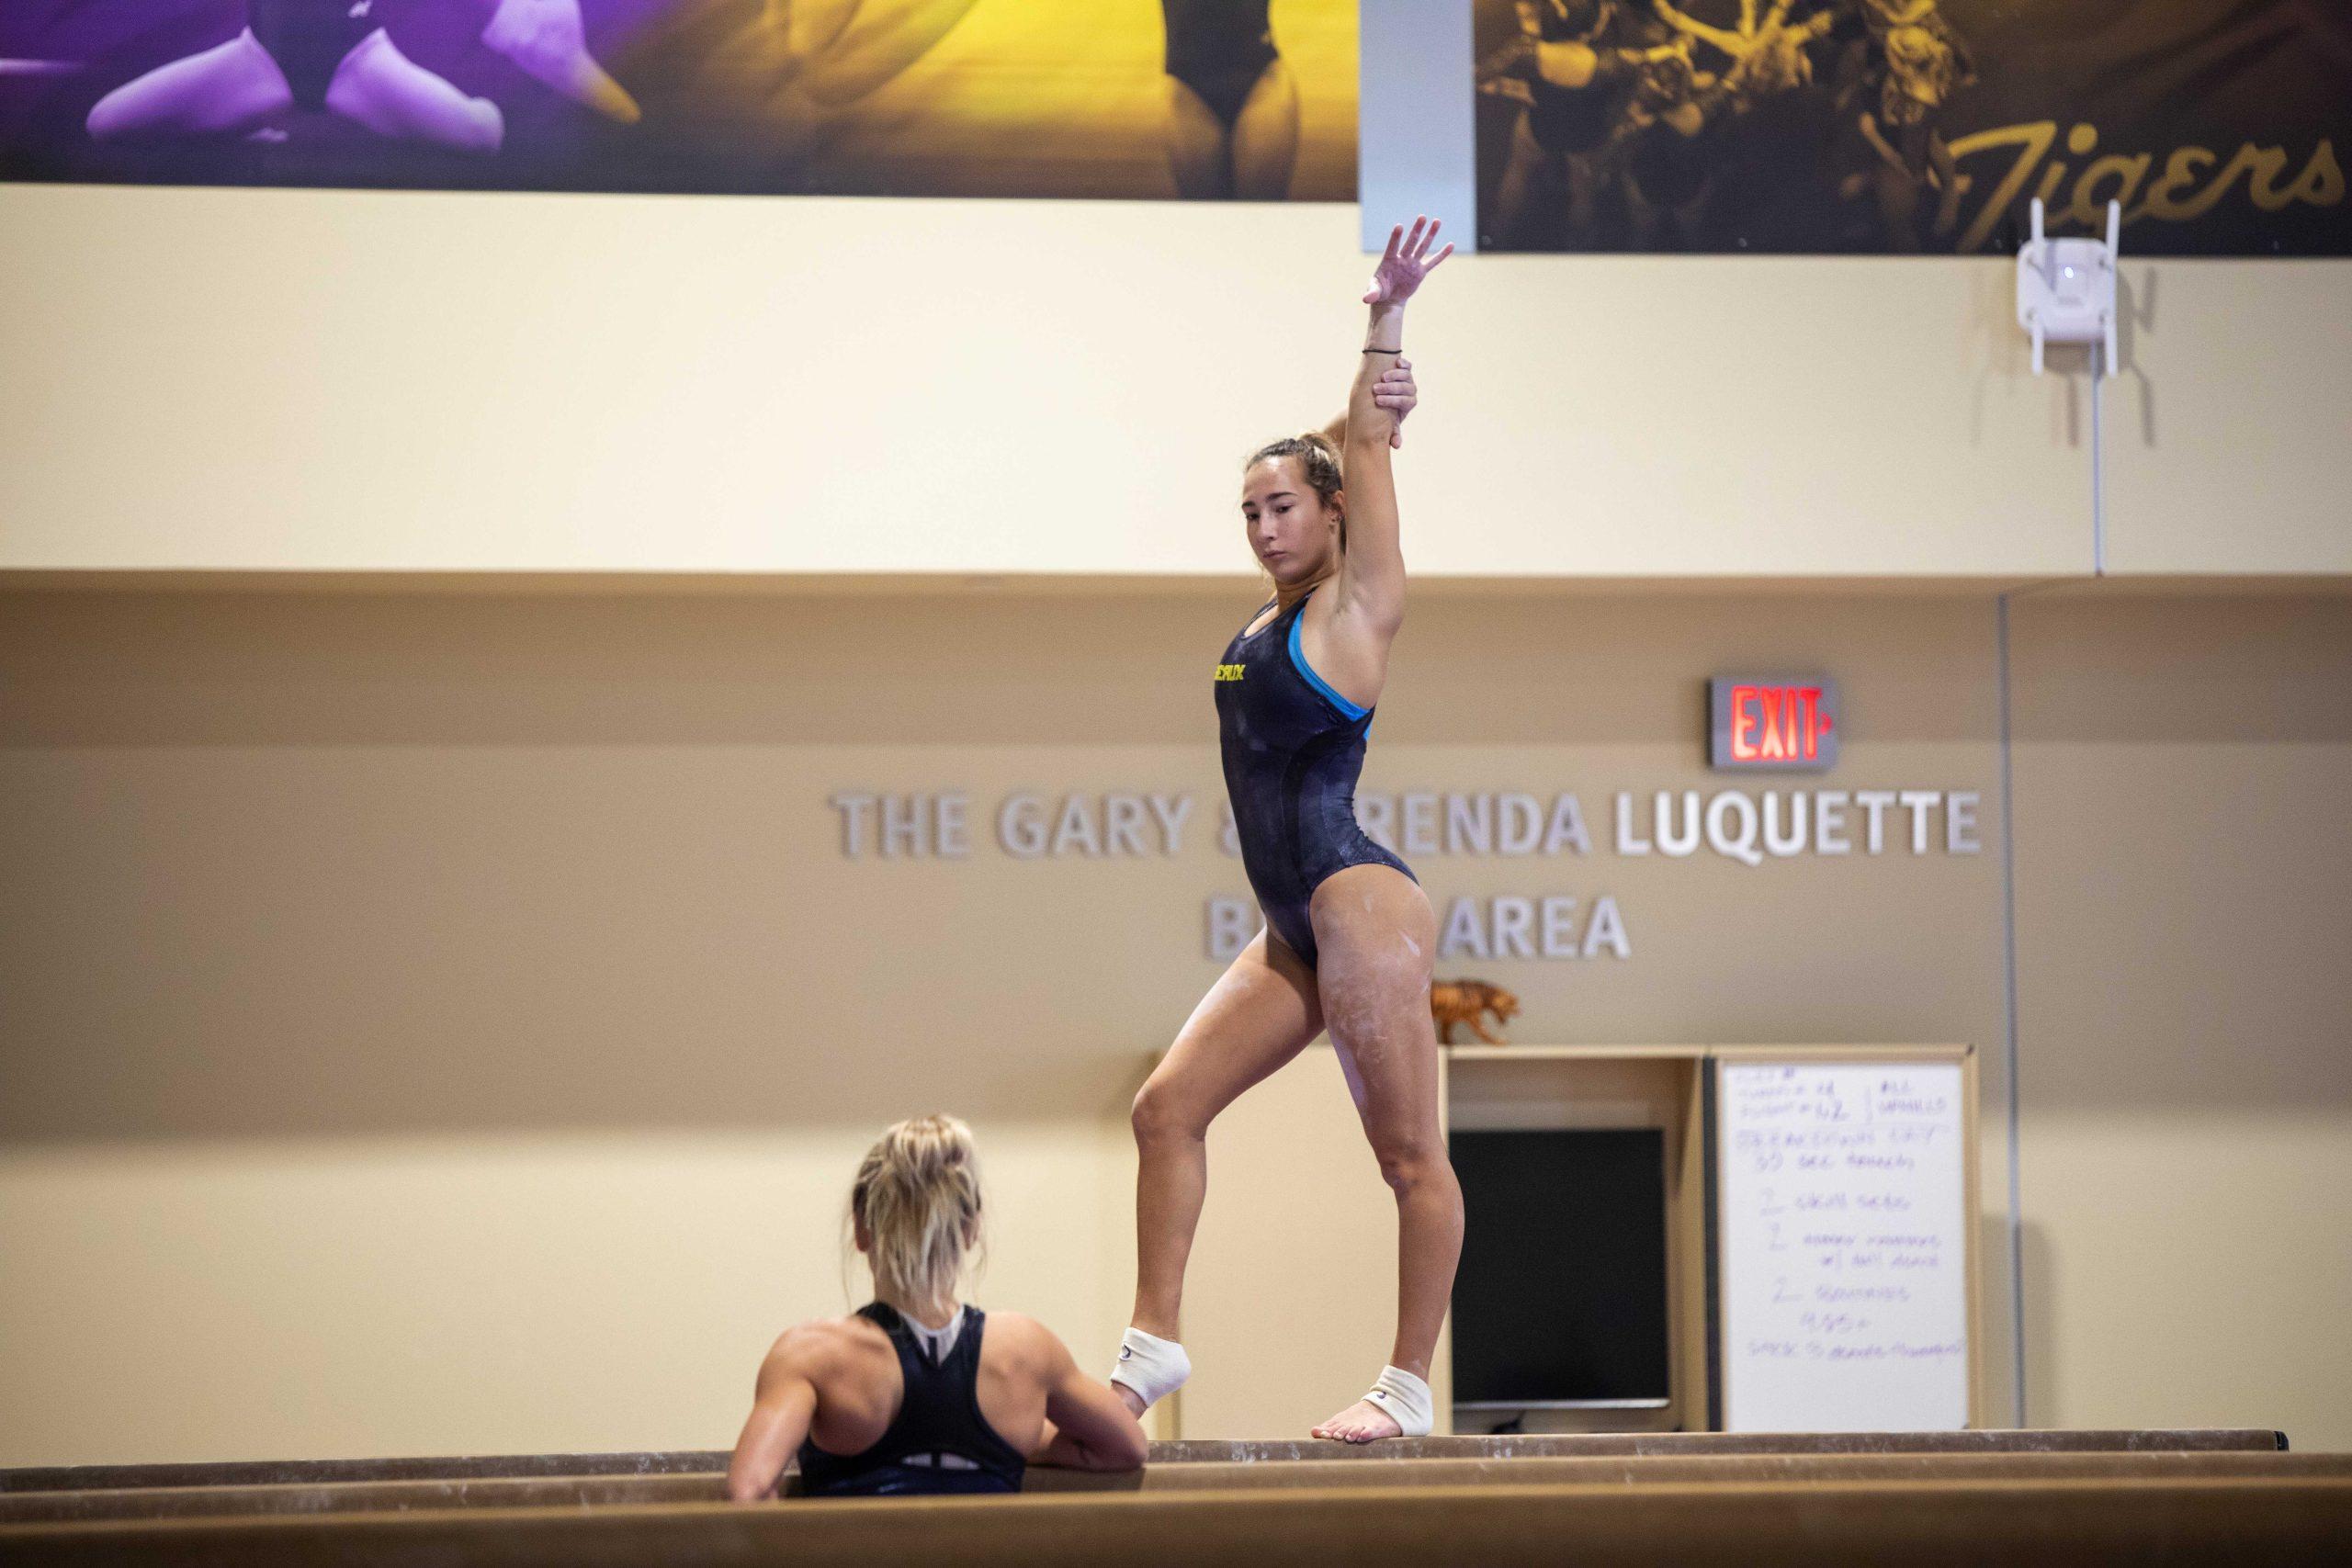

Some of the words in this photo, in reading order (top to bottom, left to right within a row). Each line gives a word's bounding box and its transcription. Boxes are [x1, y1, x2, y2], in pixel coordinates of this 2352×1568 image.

[1947, 120, 2346, 254] Tigers
[1731, 685, 1823, 761] EXIT
[834, 794, 969, 859] THE
[1000, 794, 1193, 859] GARY
[1353, 793, 1592, 857] RENDA
[1614, 790, 1983, 865] LUQUETTE
[1441, 897, 1632, 960] AREA
